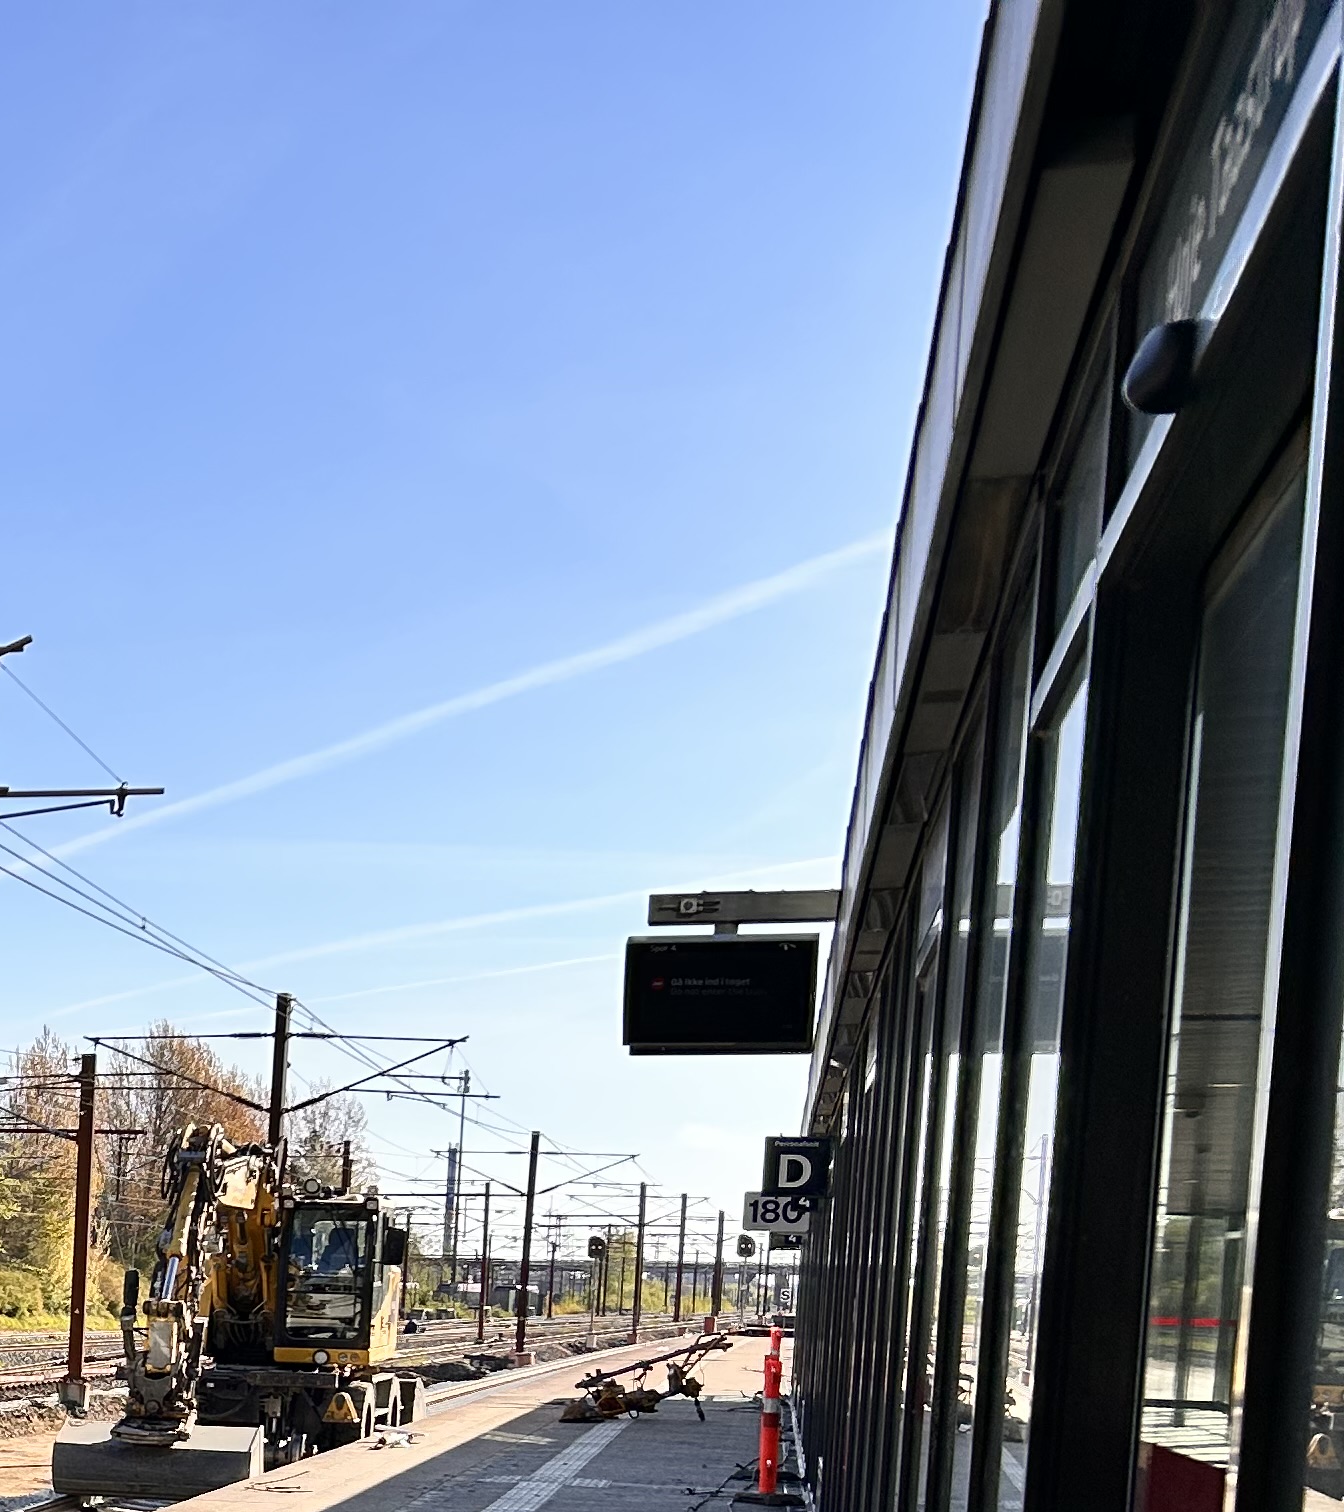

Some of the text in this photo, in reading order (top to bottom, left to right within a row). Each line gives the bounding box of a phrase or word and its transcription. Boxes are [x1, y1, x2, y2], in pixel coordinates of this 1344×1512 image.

[685, 977, 703, 986] ikke
[705, 977, 720, 986] ind
[701, 988, 727, 996] enter
[777, 1154, 812, 1188] D
[749, 1198, 803, 1223] 180
[781, 1290, 790, 1301] S
